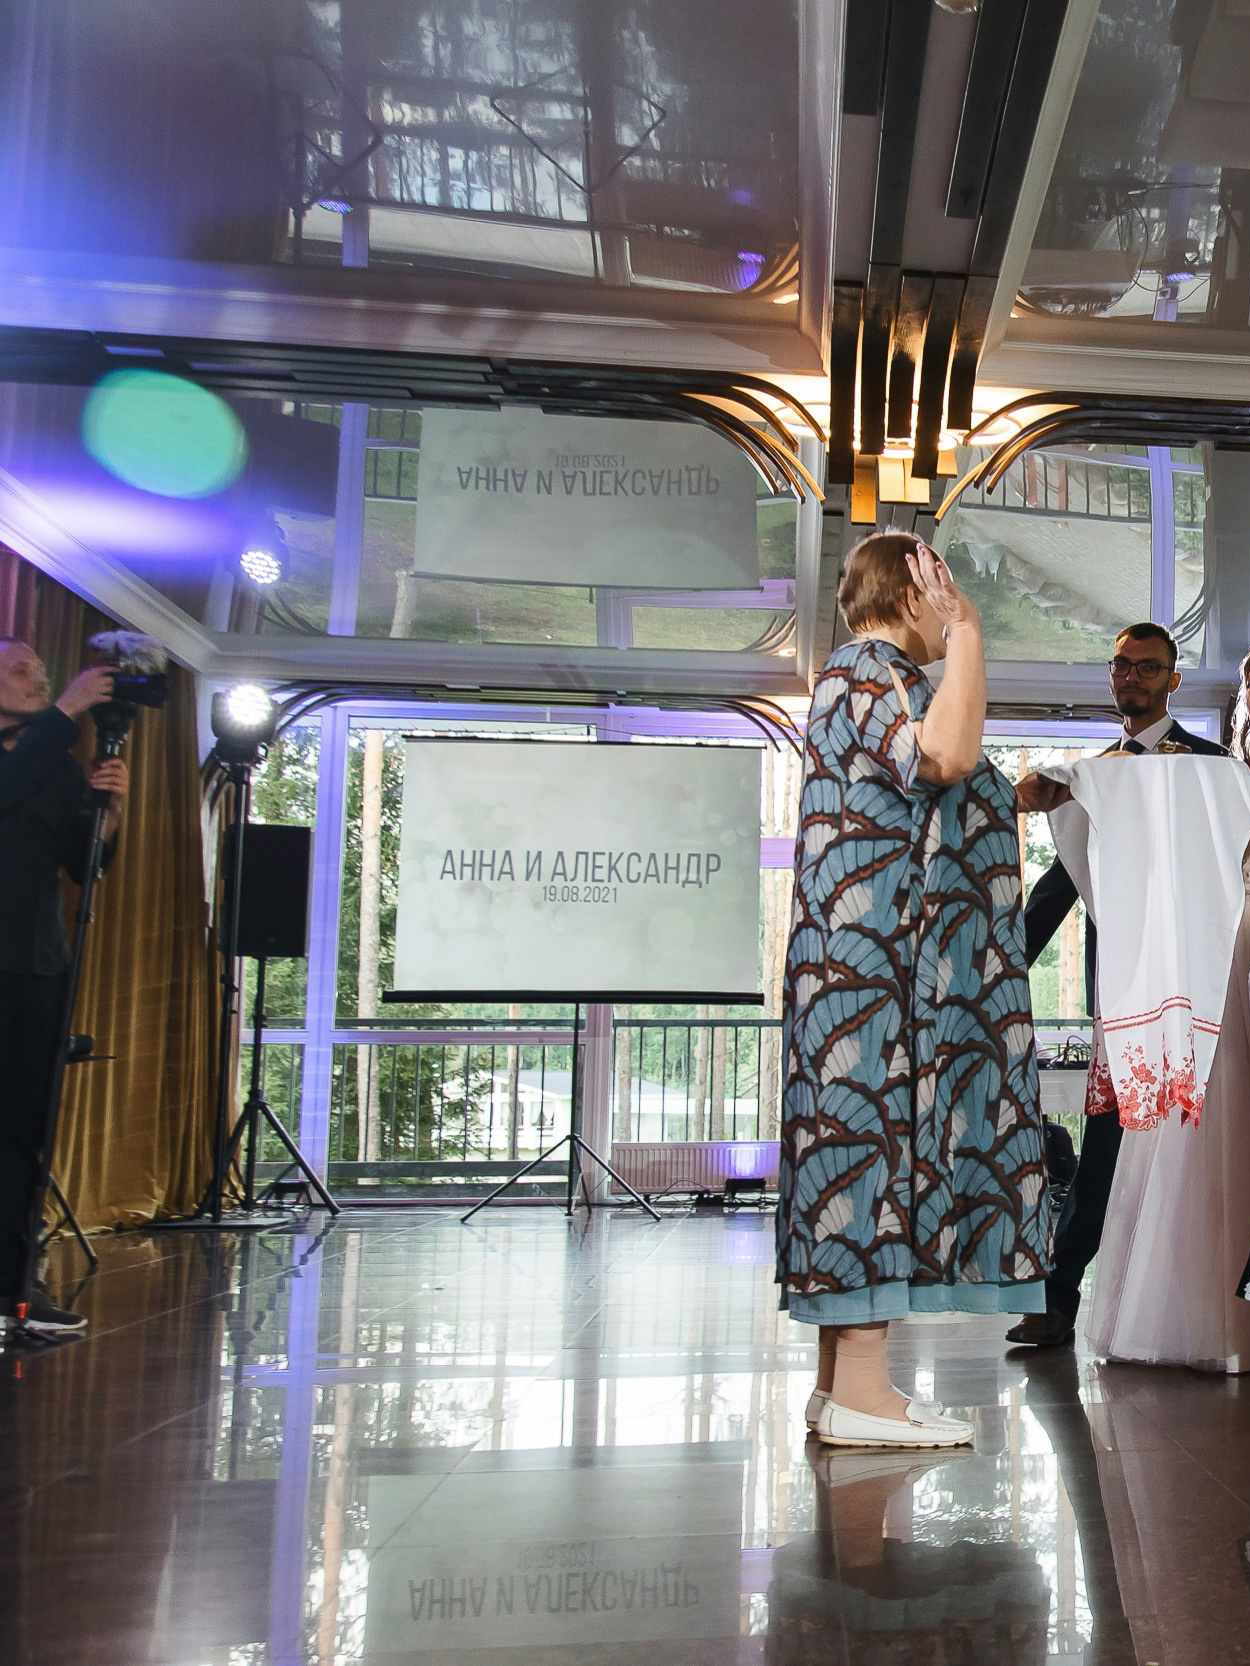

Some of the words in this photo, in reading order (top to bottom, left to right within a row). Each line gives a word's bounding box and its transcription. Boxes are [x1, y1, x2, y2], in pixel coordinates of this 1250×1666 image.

[440, 849, 515, 882] АННА
[525, 850, 542, 882] И
[550, 851, 722, 888] АЛЕКСАНДР
[542, 885, 618, 903] 19.08.2021
